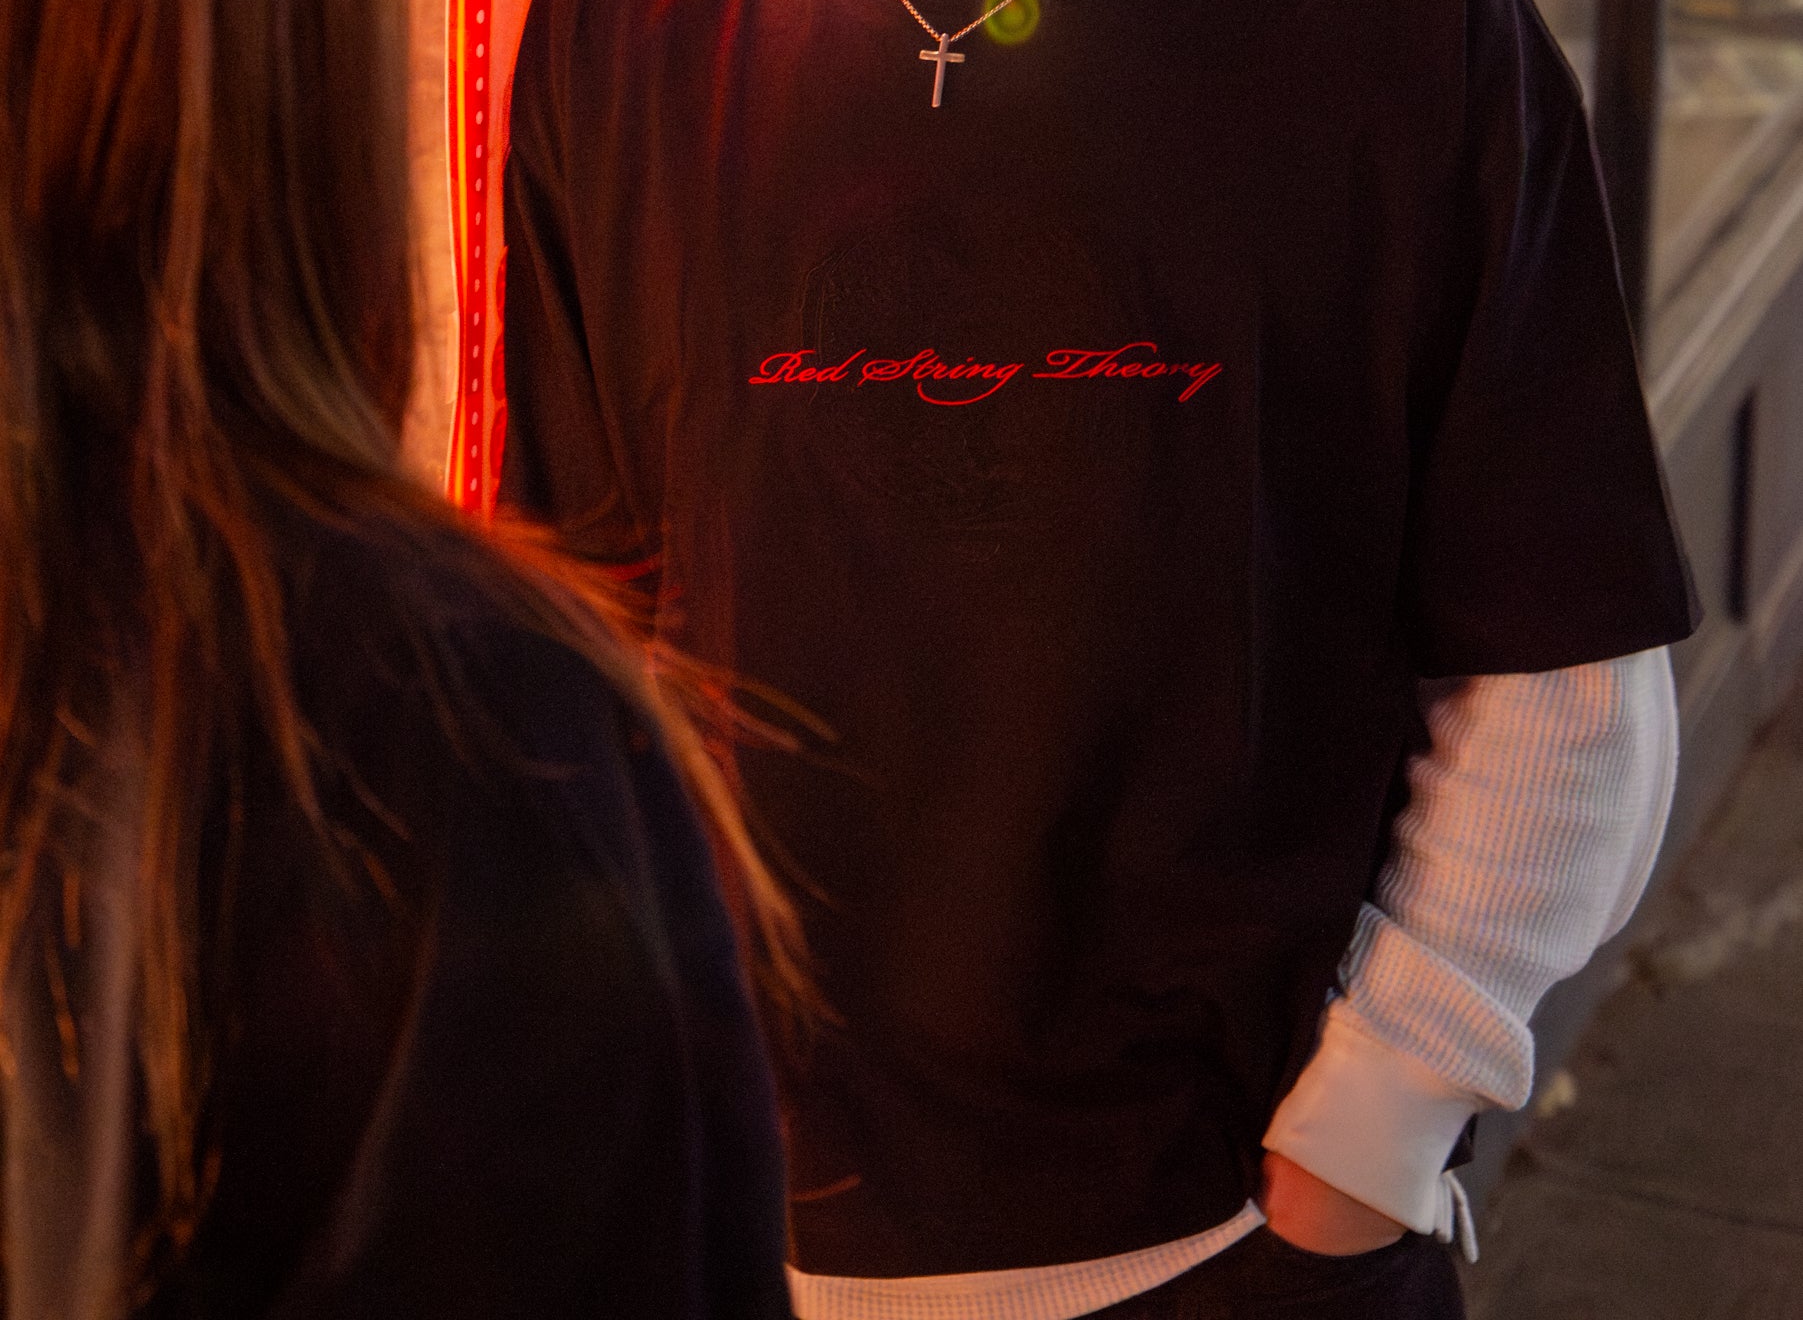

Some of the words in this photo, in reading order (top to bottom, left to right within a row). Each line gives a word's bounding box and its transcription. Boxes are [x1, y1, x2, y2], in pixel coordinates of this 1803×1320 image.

[749, 349, 866, 384] Red
[858, 348, 1025, 406] String
[1032, 341, 1223, 403] Theory
